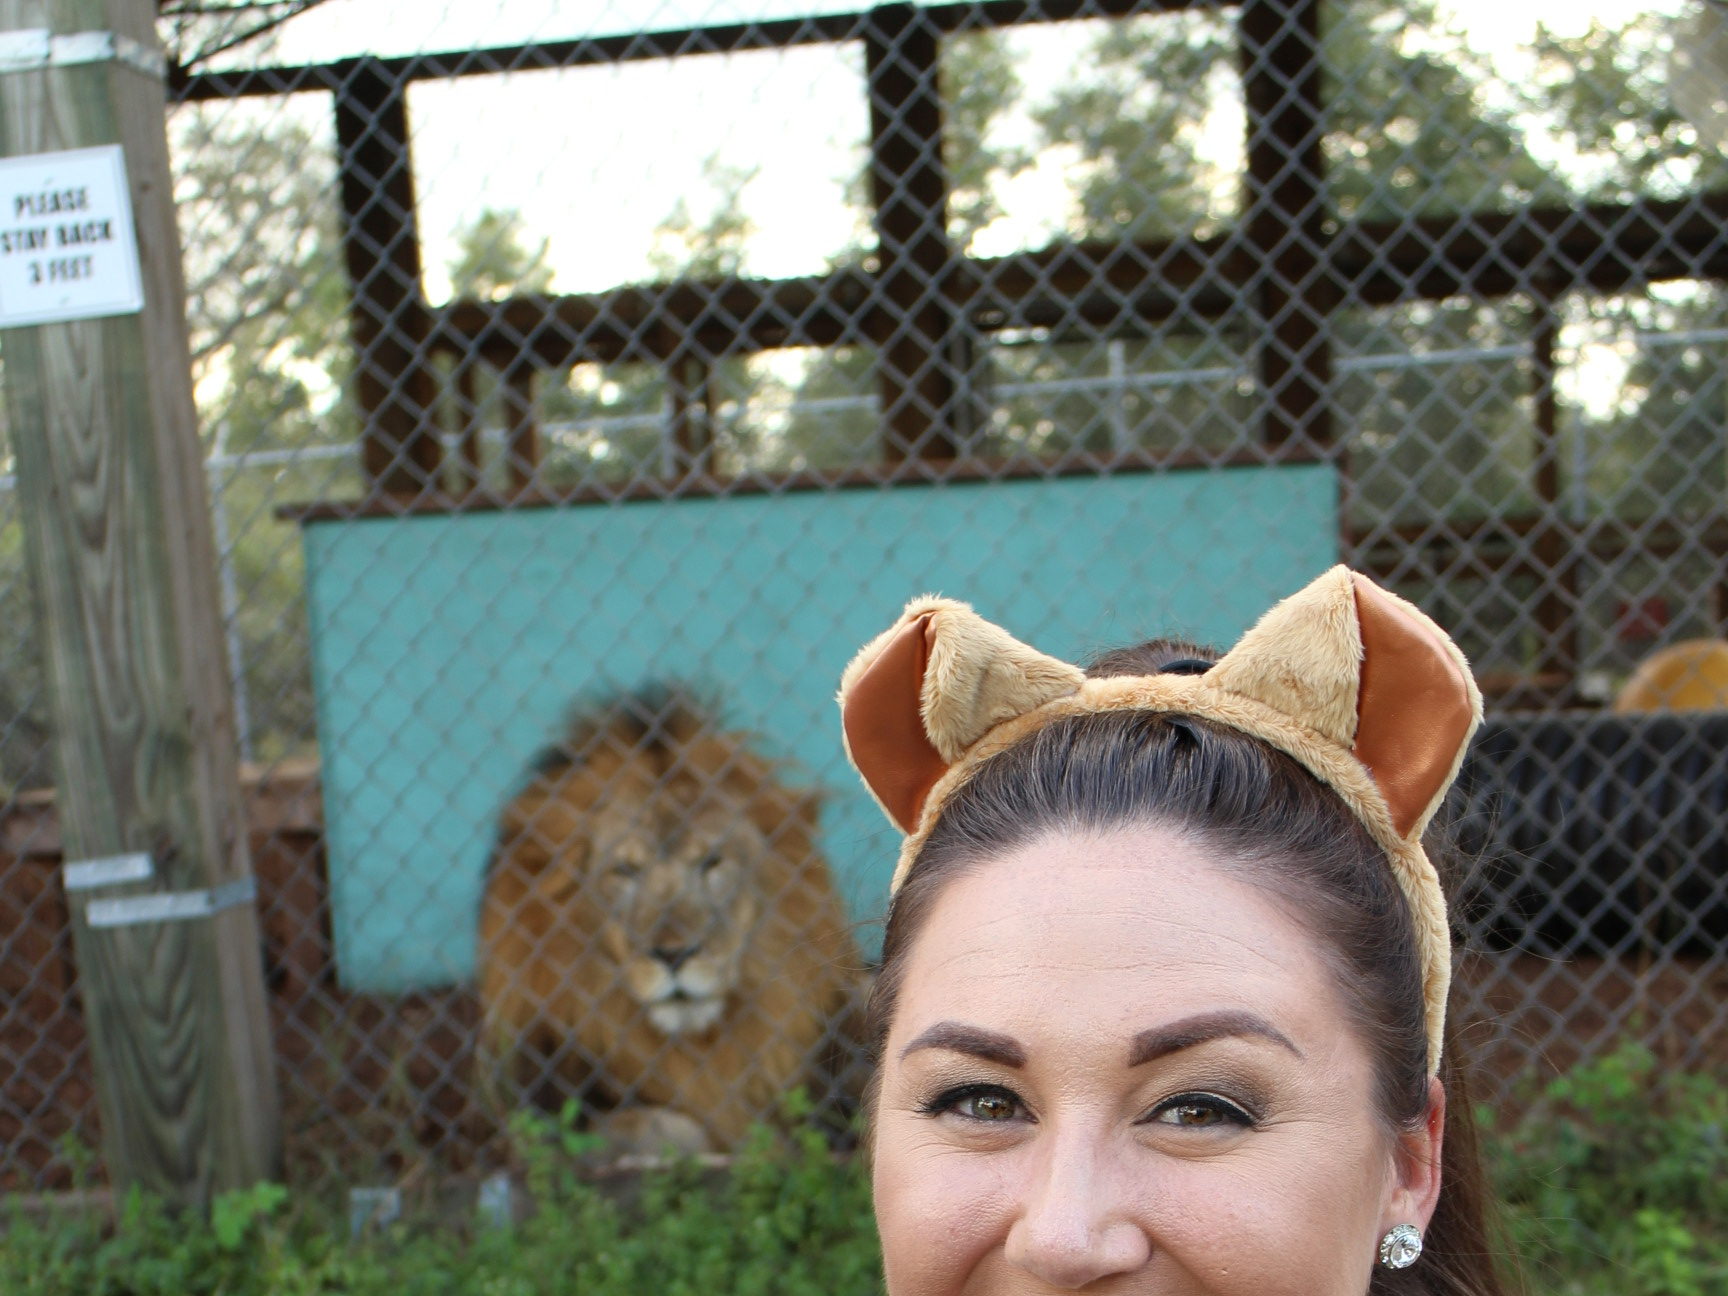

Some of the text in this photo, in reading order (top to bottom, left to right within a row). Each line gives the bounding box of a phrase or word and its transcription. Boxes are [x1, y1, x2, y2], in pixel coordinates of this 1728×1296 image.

[15, 187, 87, 217] PLEASE
[0, 219, 113, 252] STAY BACK
[49, 255, 93, 282] FEET
